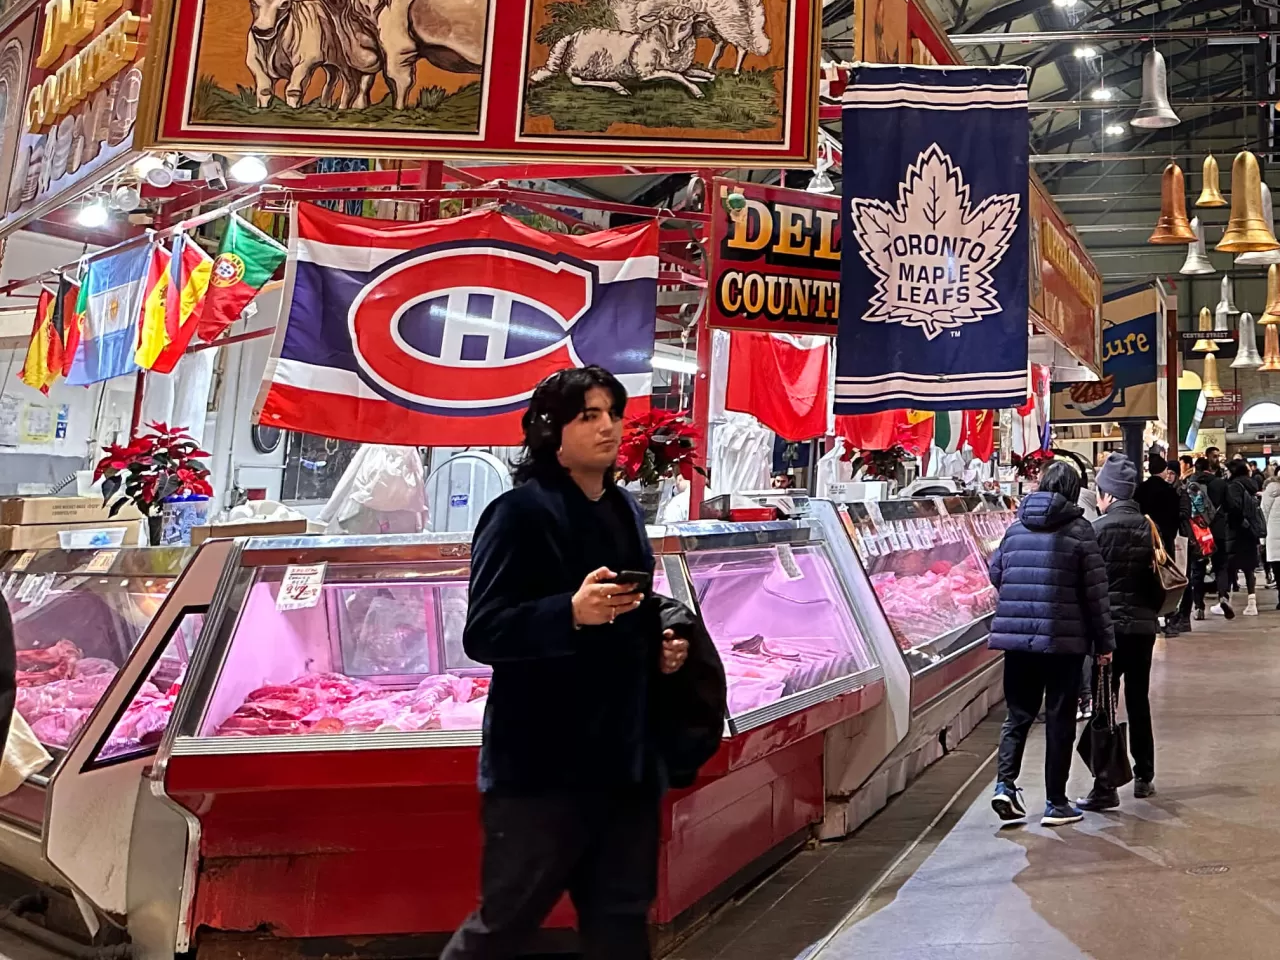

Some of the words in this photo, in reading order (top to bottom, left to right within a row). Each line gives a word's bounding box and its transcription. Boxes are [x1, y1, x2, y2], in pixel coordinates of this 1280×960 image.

[727, 198, 842, 260] DEL
[883, 234, 986, 263] TORONTO
[899, 262, 970, 285] MAPLE
[721, 271, 840, 319] COUNT
[897, 284, 970, 305] LEAFS
